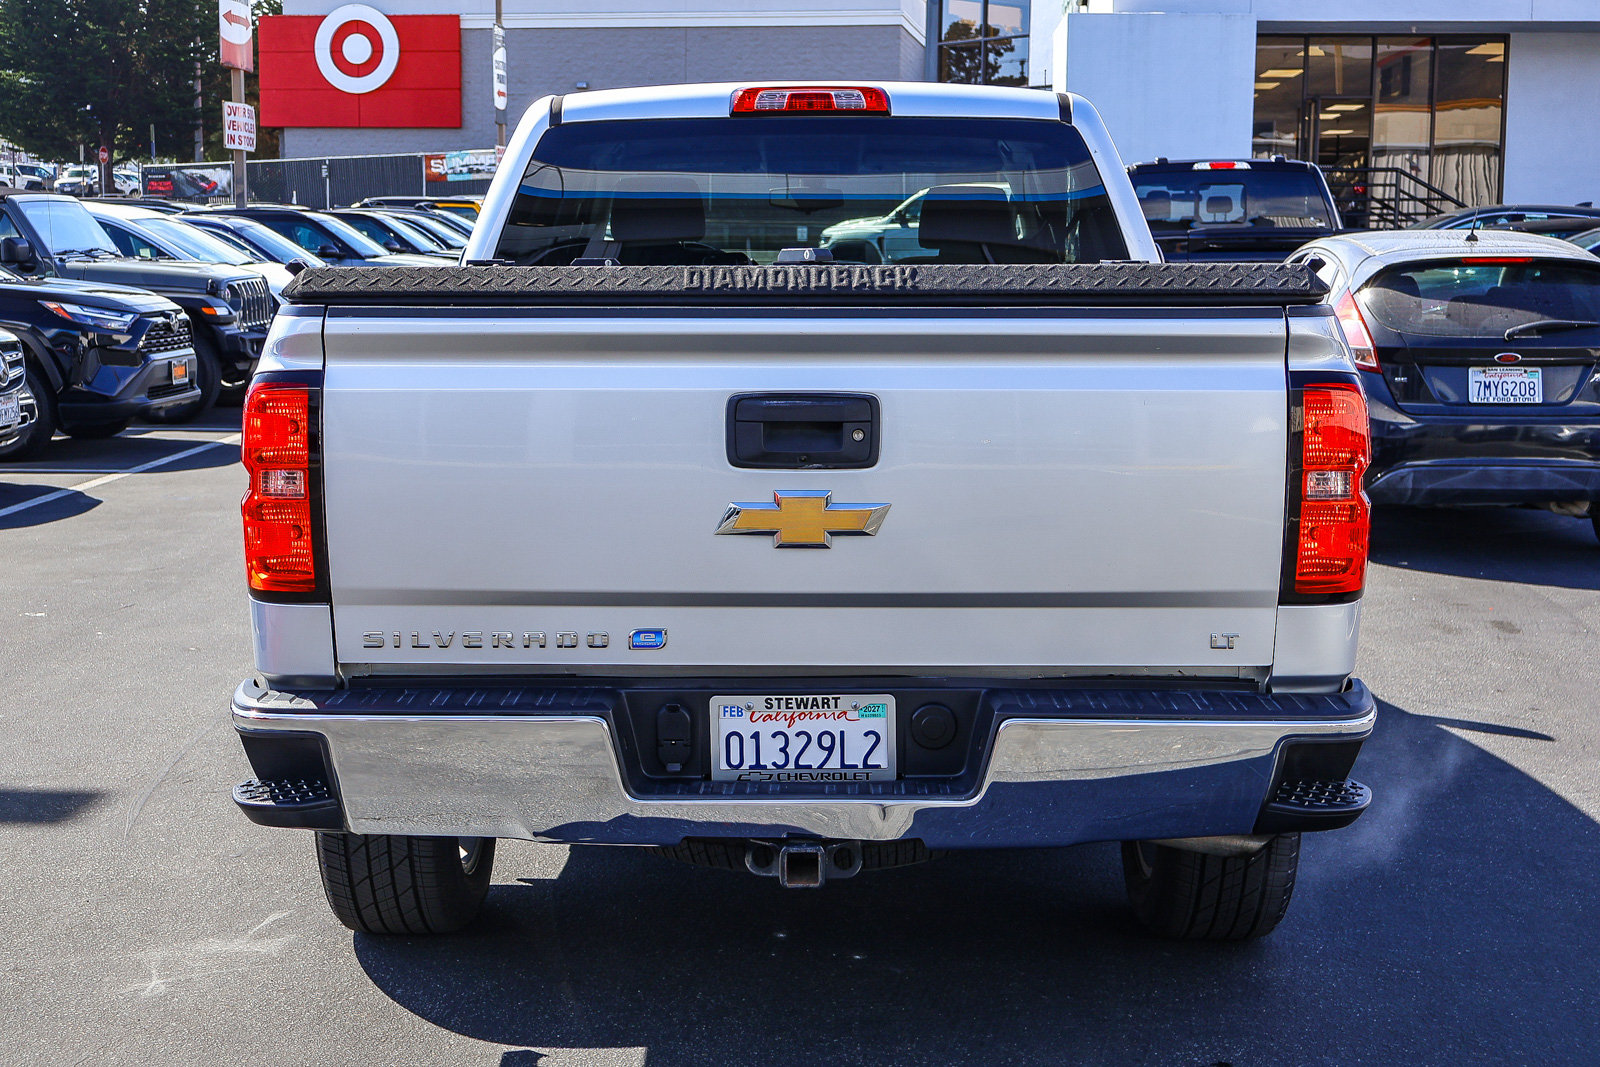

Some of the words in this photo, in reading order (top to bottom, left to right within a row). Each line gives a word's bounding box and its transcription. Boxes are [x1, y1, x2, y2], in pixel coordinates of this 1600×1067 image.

[227, 105, 246, 118] OVER
[227, 120, 254, 134] VEHICLES
[227, 134, 235, 145] IN
[238, 135, 254, 148] STOCK
[683, 266, 918, 290] DIAMONDBACK
[1474, 380, 1537, 397] 7MYG208
[362, 630, 609, 649] SILVERADO
[1210, 632, 1240, 650] LT
[764, 696, 841, 710] STEWART
[863, 705, 880, 713] 2027
[723, 706, 744, 718] FEB
[750, 711, 860, 728] California
[725, 730, 882, 770] 01329L2
[777, 772, 872, 781] CHEVROLET
